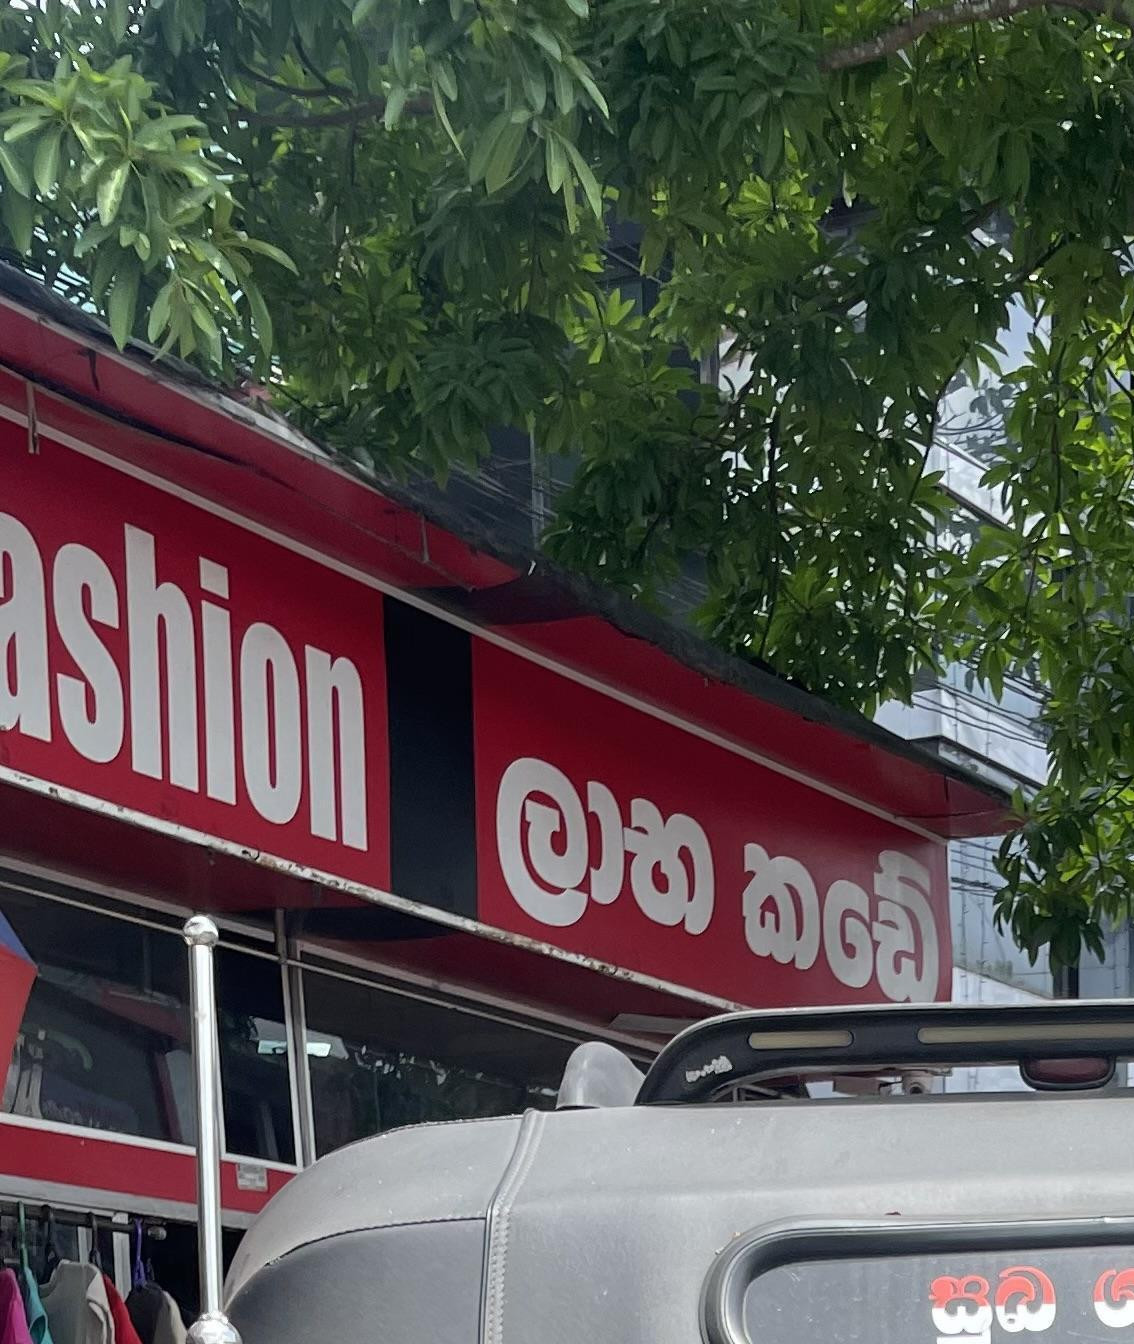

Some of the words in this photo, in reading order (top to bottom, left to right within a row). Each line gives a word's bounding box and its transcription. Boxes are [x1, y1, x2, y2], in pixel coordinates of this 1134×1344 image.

[0, 511, 369, 852] ashion
[496, 757, 715, 935] ලාභ
[742, 842, 940, 1002] කඩේ
